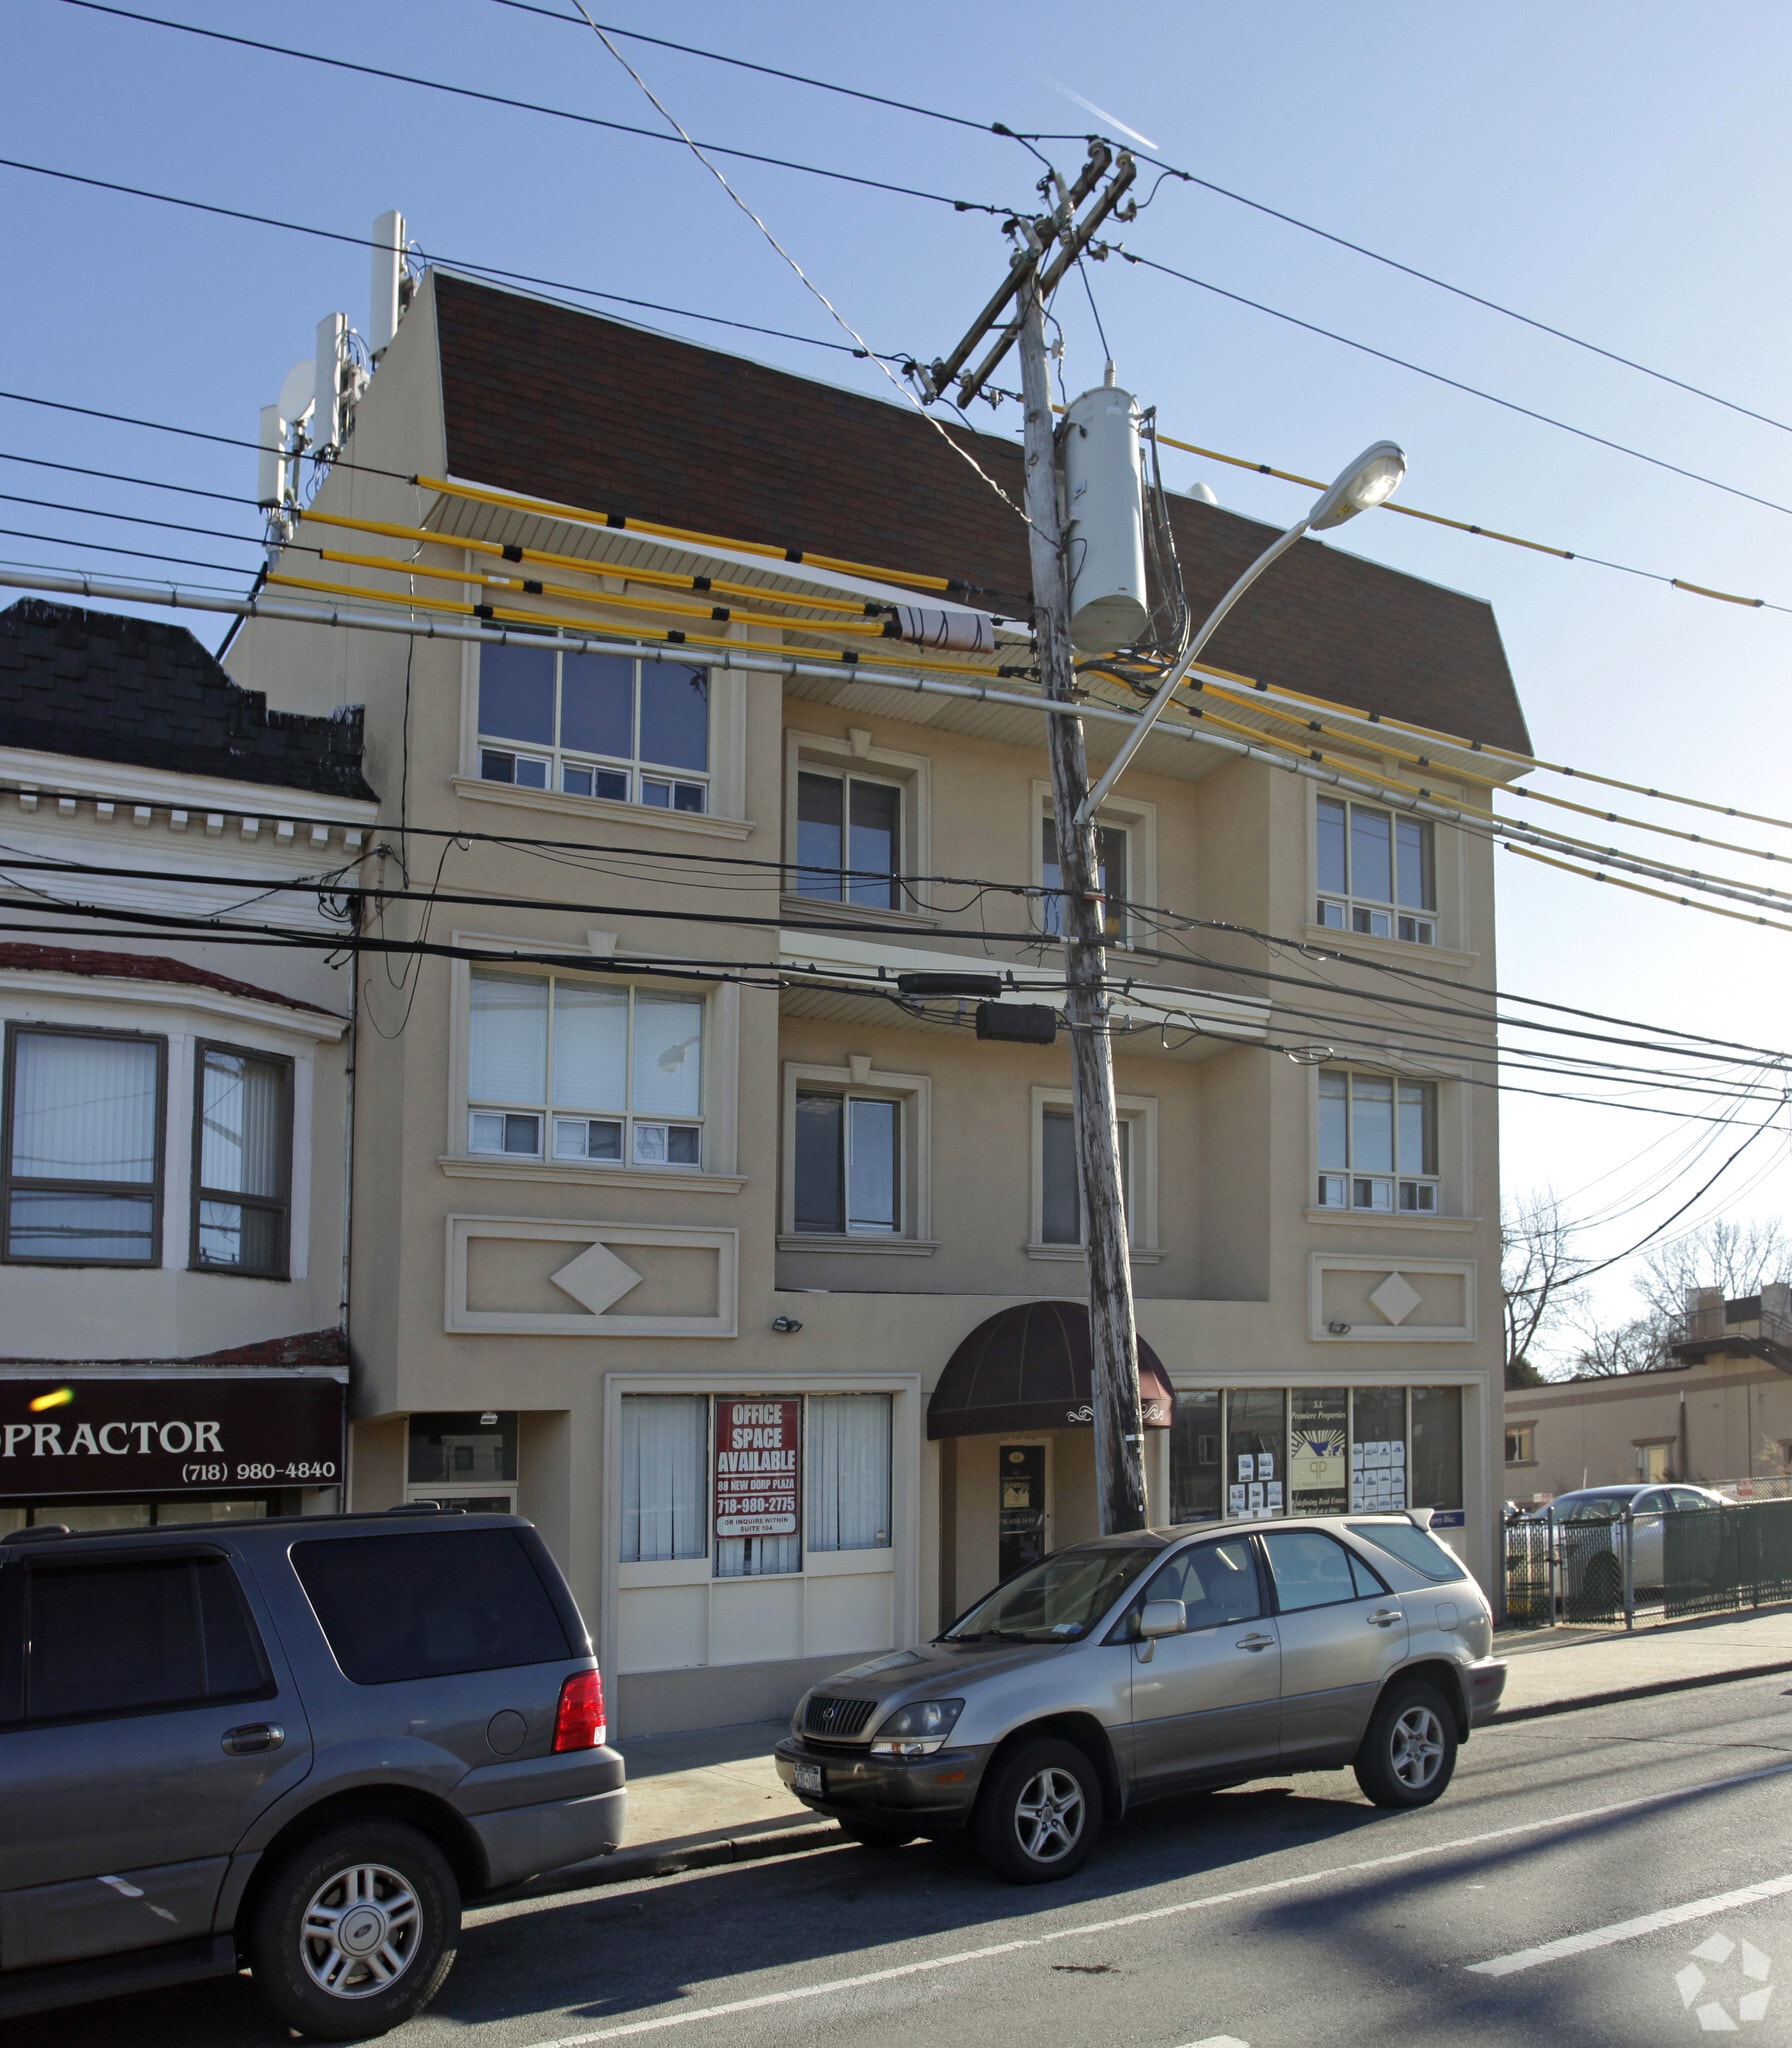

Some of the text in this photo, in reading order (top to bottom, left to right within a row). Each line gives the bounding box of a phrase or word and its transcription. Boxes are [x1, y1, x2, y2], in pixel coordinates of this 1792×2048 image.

[732, 1404, 782, 1425] OFFICE
[1317, 1410, 1346, 1421] Properties
[0, 1421, 225, 1457] PRACTOR
[732, 1427, 782, 1449] SPACE
[718, 1450, 796, 1473] AVAILABLE
[182, 1462, 336, 1482] (718) 980-4840
[717, 1478, 795, 1491] 88 NEW DORP PLAZA
[717, 1497, 795, 1514] 718-980-2775
[735, 1518, 763, 1526] INQUIRE
